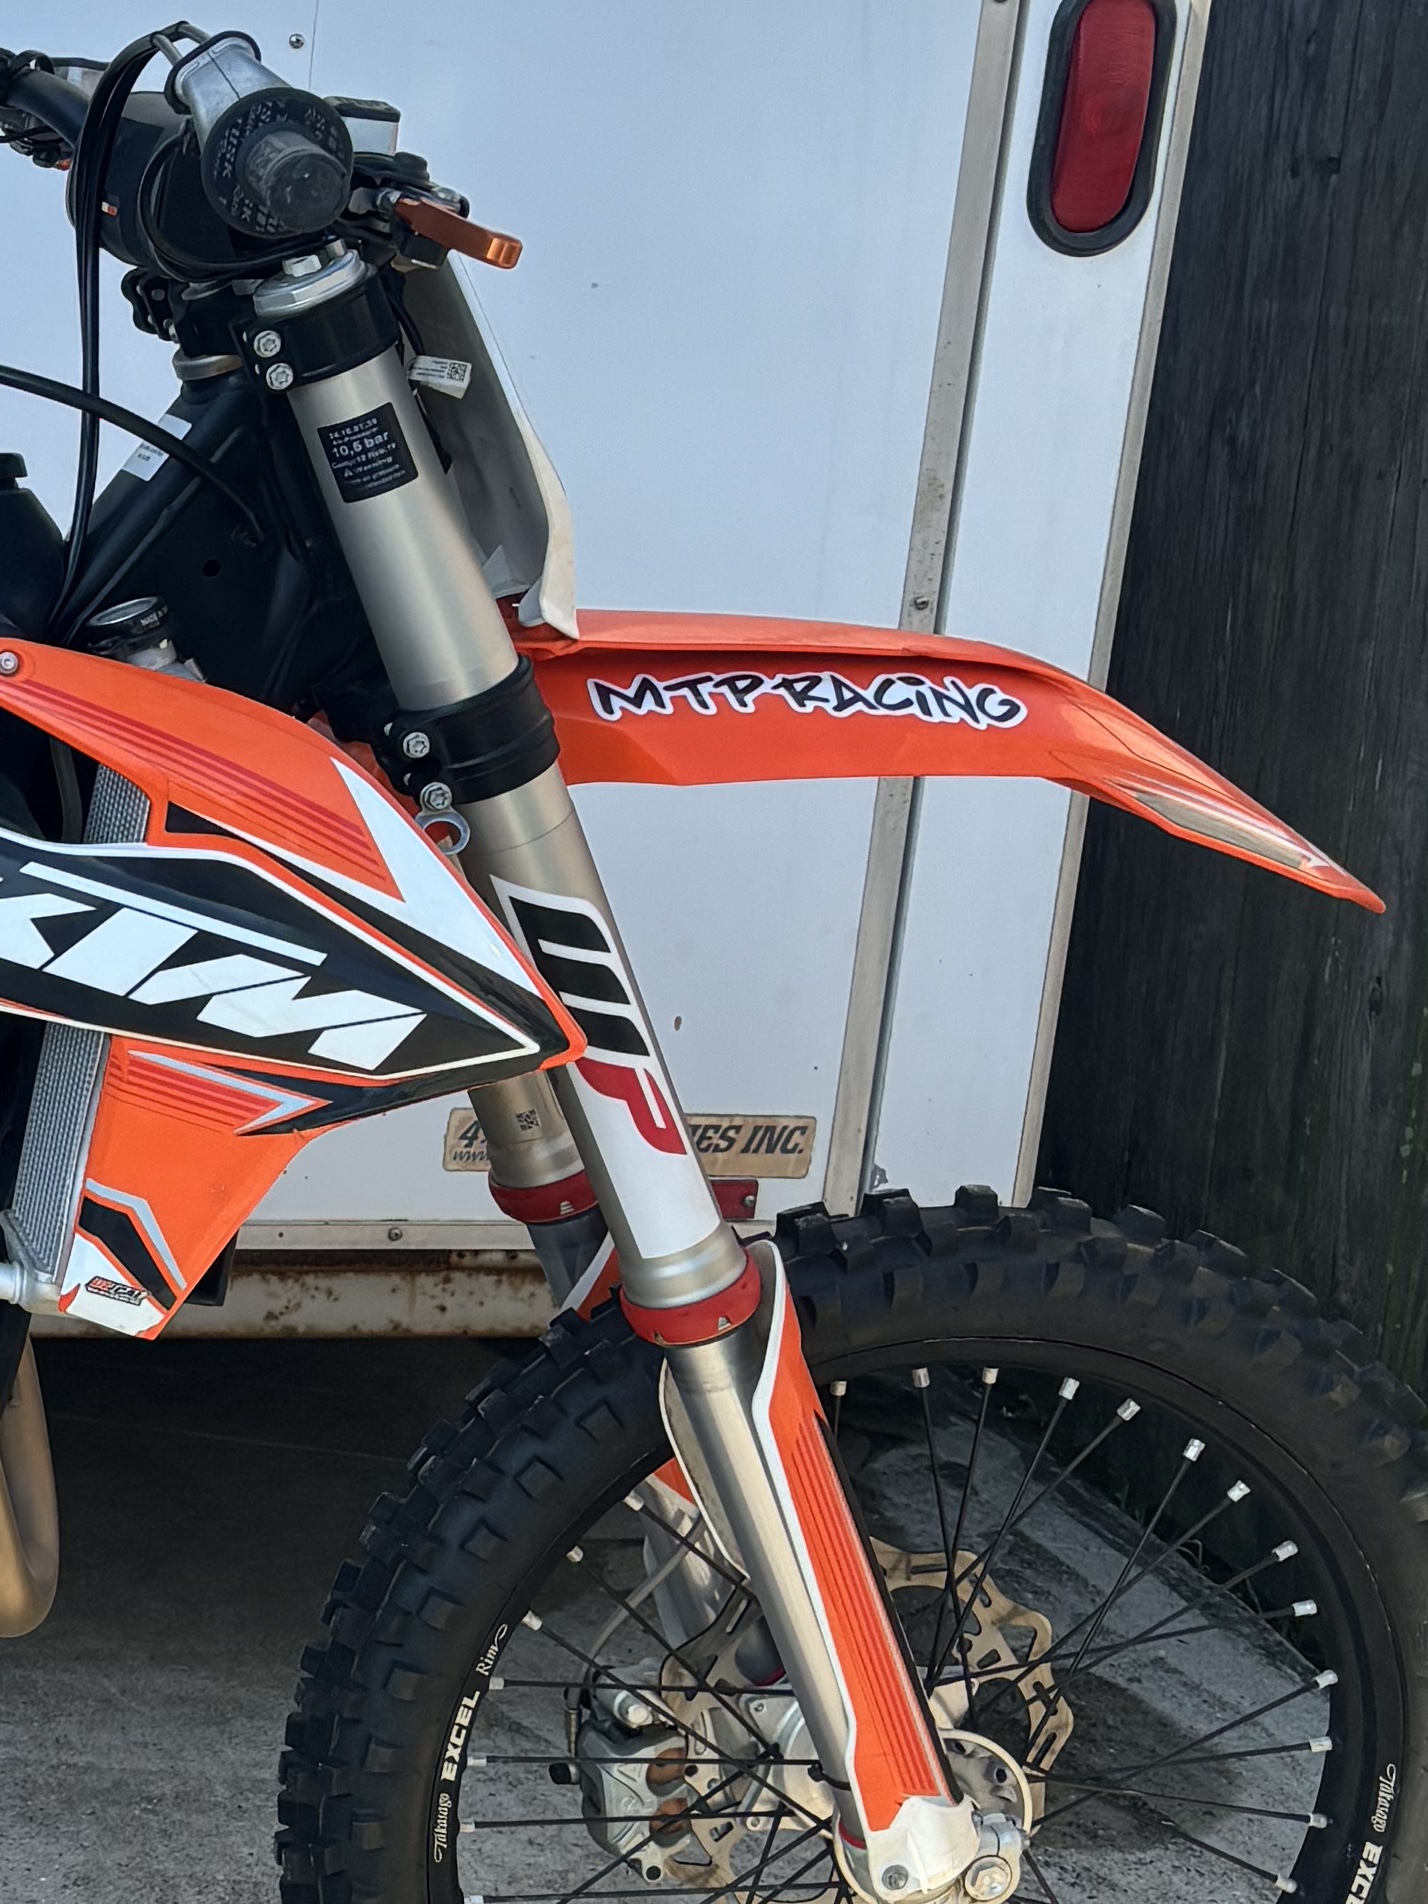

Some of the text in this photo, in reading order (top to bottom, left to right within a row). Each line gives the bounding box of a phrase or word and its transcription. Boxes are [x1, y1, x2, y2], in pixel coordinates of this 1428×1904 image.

[741, 1125, 808, 1155] INC.
[440, 1690, 481, 1782] EXCEL
[475, 1623, 508, 1676] Rim
